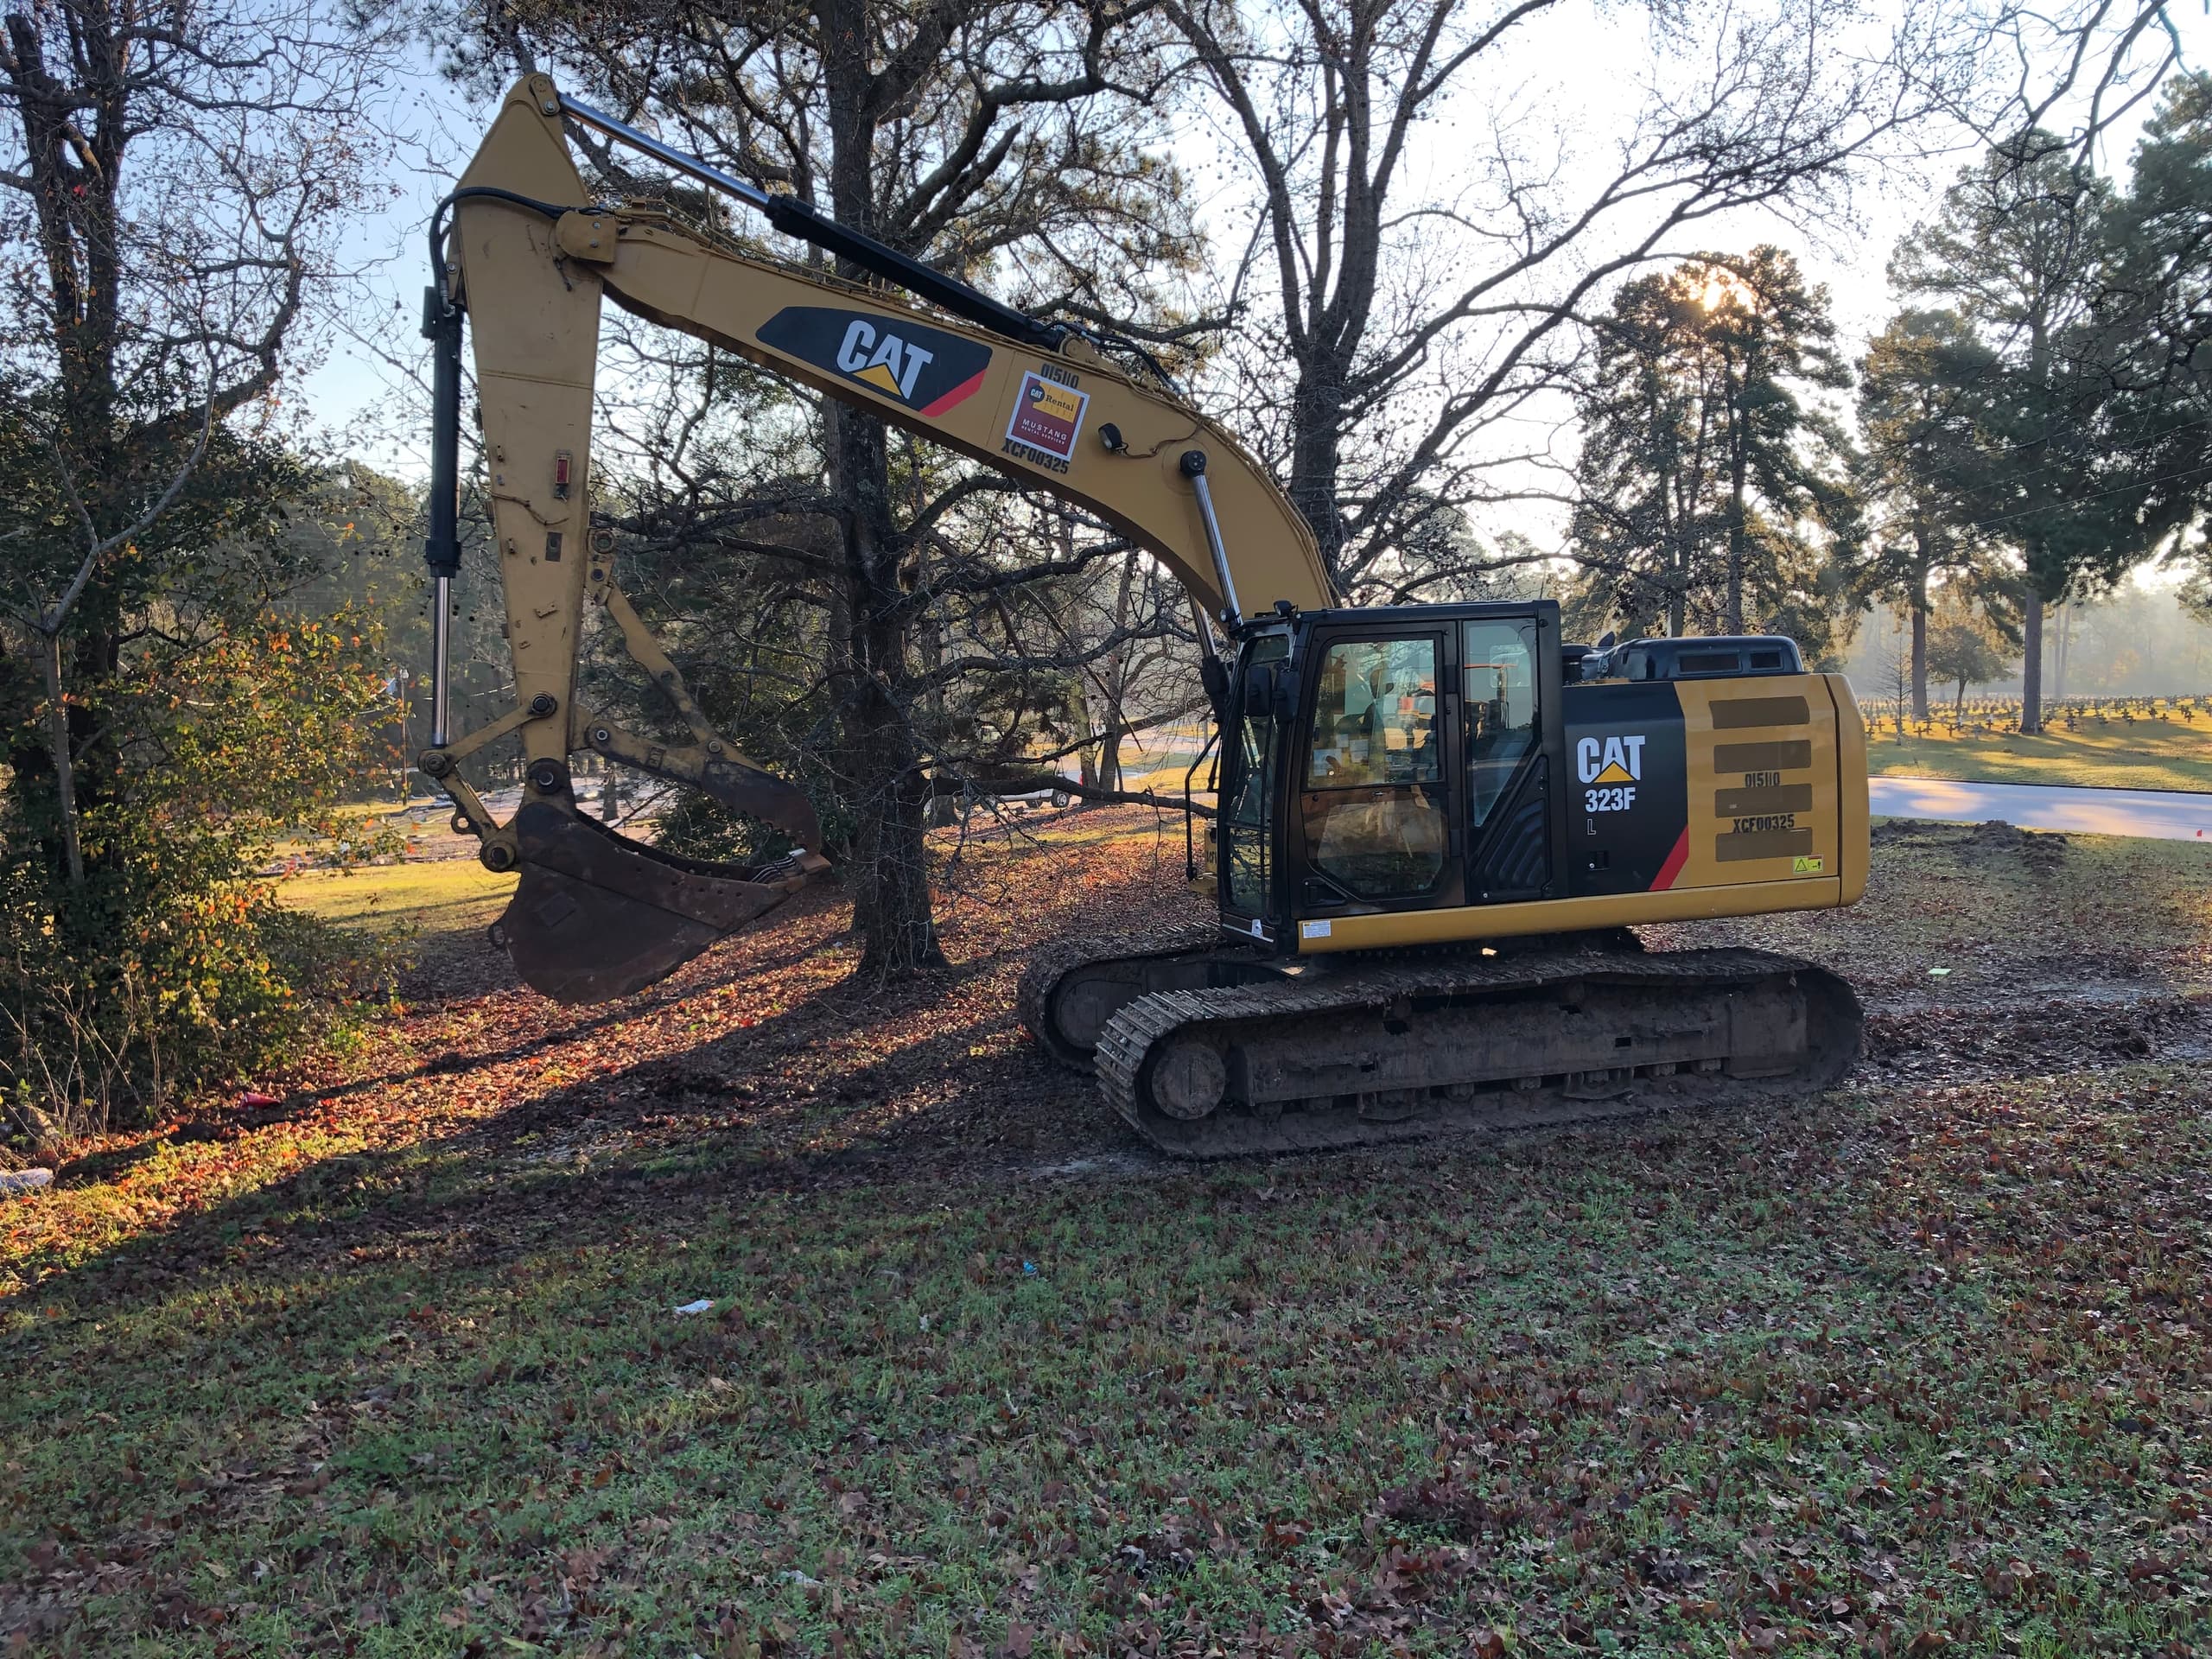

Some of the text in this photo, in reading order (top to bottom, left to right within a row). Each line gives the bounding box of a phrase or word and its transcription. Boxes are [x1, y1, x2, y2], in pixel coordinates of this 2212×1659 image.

[836, 320, 933, 399] CAT
[1030, 388, 1042, 399] CAT
[1046, 394, 1074, 411] Rental
[1022, 418, 1067, 440] MUSTANG
[1001, 439, 1070, 474] XCF00325
[1577, 735, 1645, 784] CAT
[1585, 787, 1636, 812] 323F
[1587, 818, 1597, 835] L
[1733, 814, 1795, 834] XCF00325
